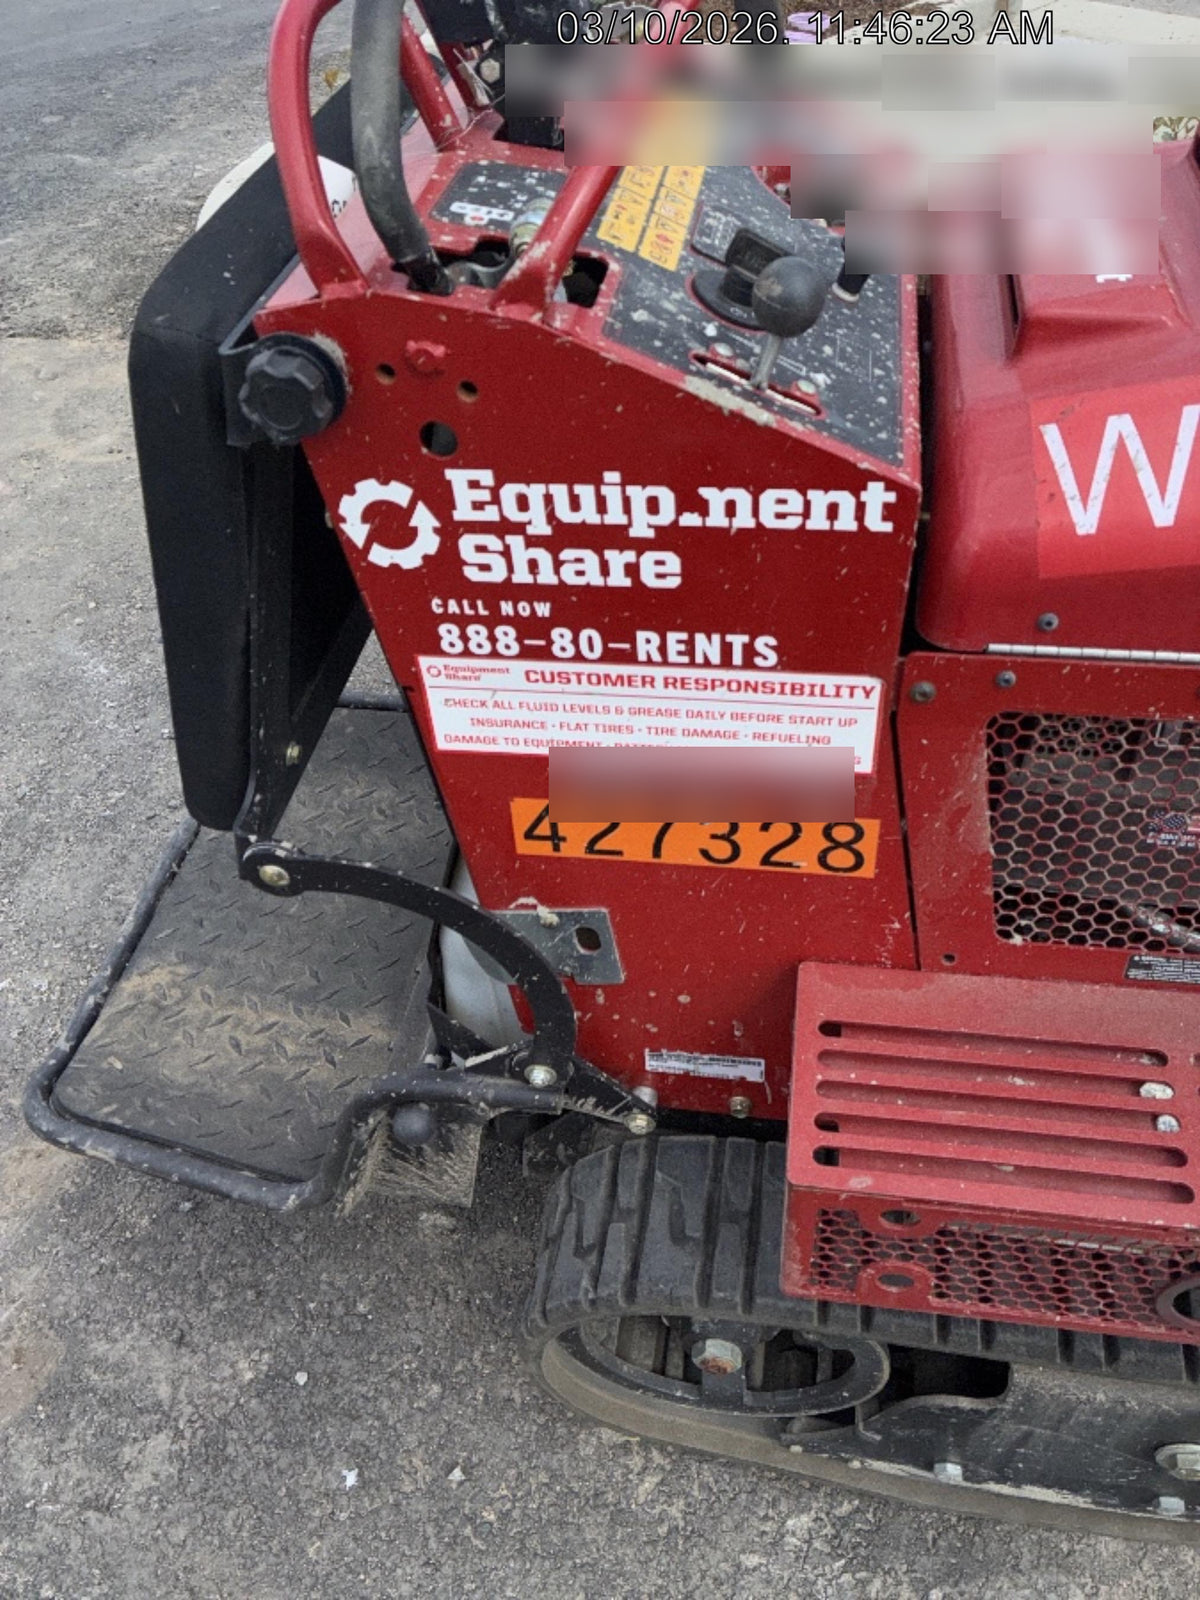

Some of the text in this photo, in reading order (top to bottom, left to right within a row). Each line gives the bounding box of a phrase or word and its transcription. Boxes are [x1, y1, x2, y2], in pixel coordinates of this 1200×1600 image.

[458, 533, 682, 588] Share
[431, 597, 551, 617] CALL NOW
[438, 622, 779, 668] 888-80-RENTS
[524, 669, 876, 700] CUSTOMER RESPONSIBILITY
[444, 697, 488, 709] CHECK
[492, 699, 515, 711] ALL
[518, 701, 559, 712] FLUID
[563, 704, 611, 715] LEVELS
[628, 706, 681, 718] GREASE
[685, 709, 726, 721] DAILY
[730, 711, 785, 724] BEFORE
[788, 714, 834, 727] START
[838, 718, 859, 728] UP
[444, 734, 500, 746] DAMAGE
[503, 737, 521, 747] TO
[470, 717, 832, 746] INSURANCE FLAT TIRES TIRE DAMAGE REFUELING
